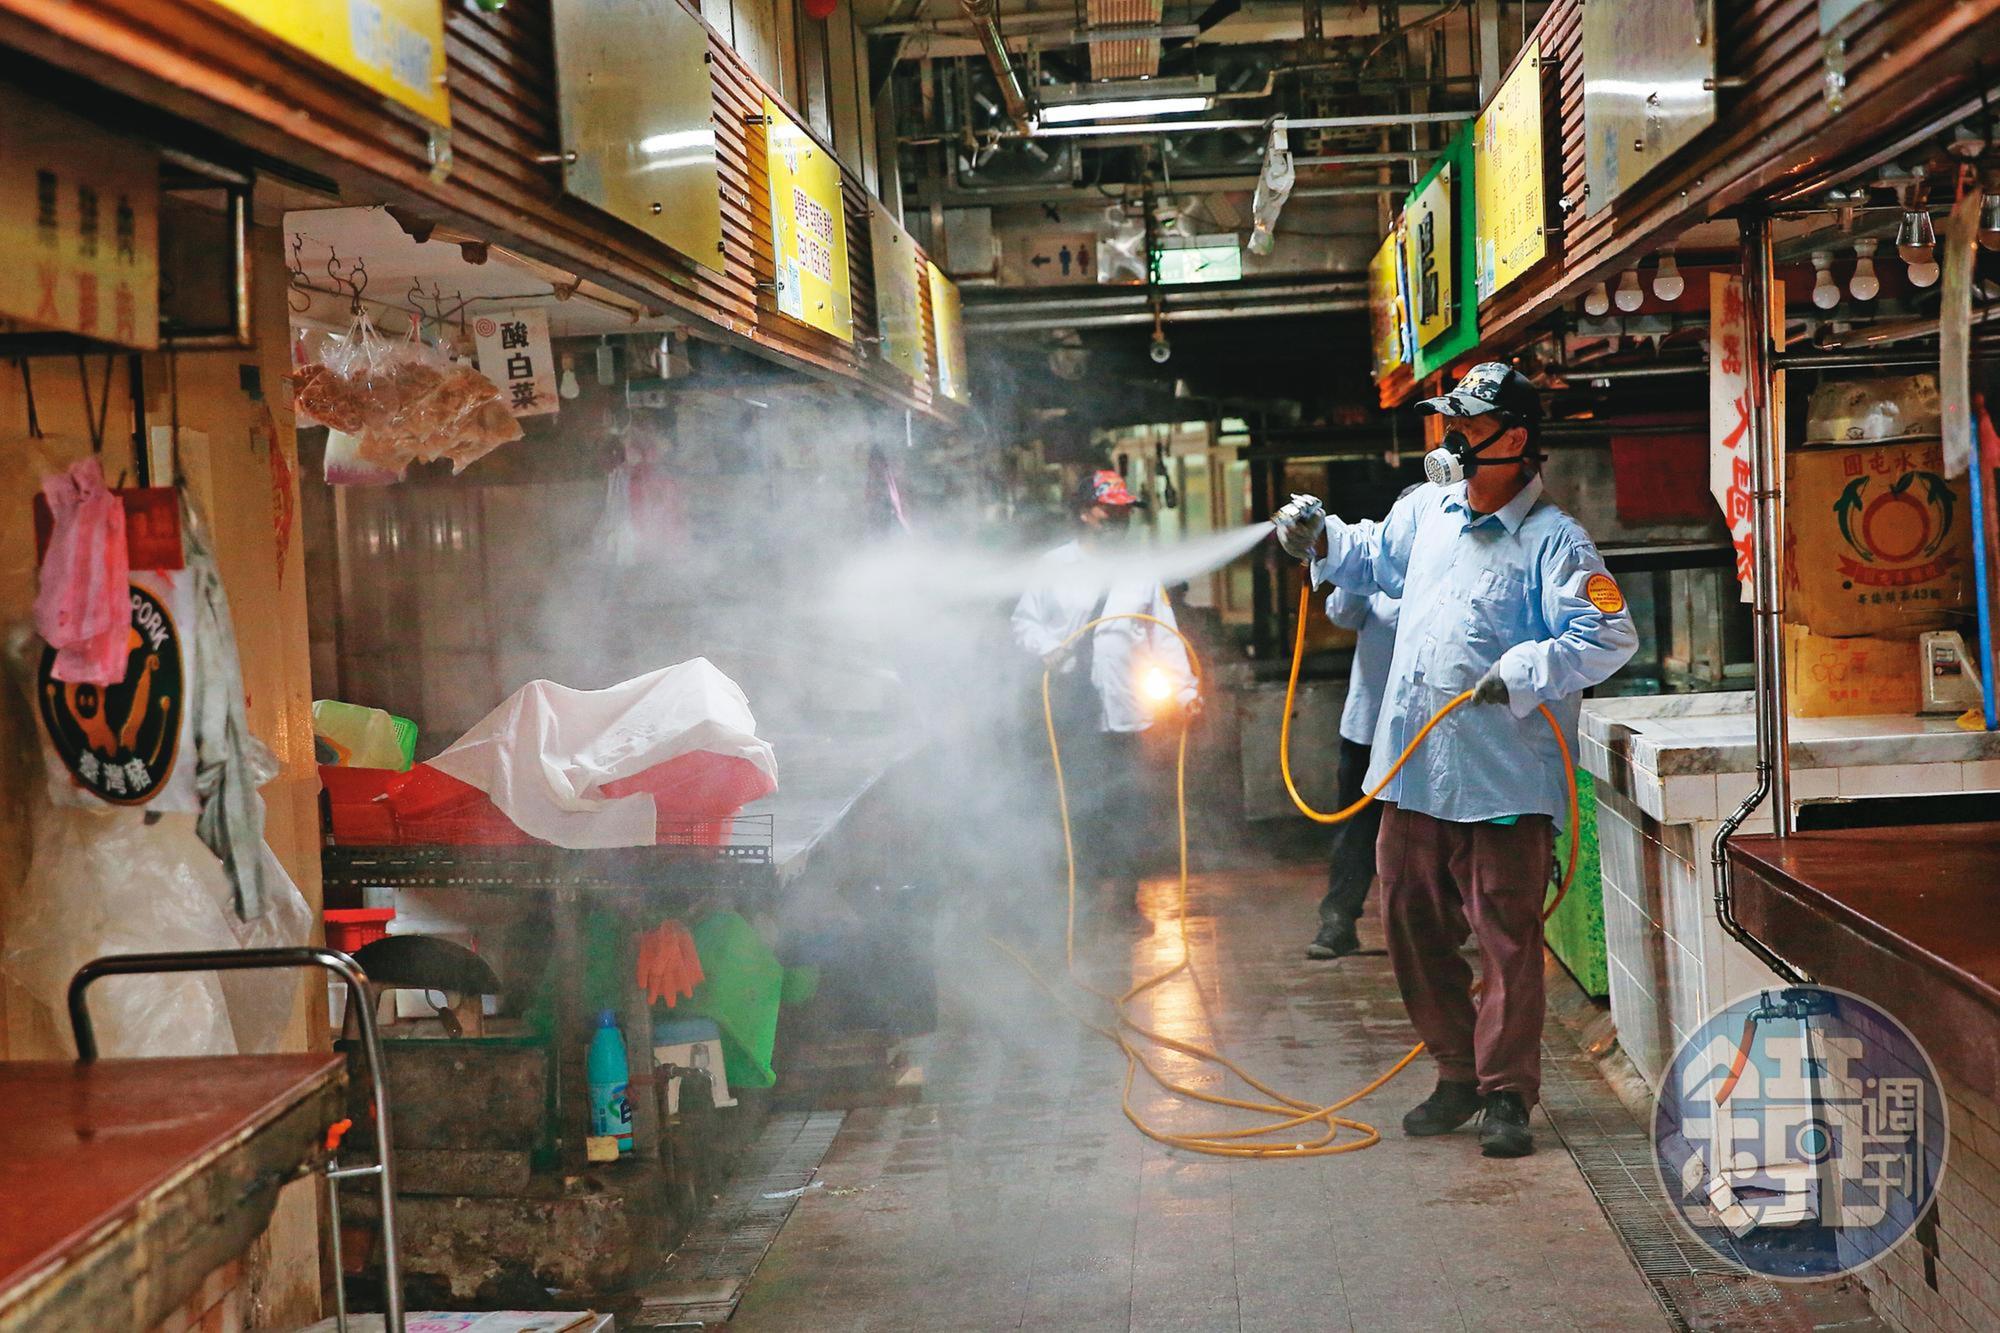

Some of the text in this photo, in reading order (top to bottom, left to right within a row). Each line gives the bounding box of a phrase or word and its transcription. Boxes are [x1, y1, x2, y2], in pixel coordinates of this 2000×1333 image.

[500, 320, 538, 409] 酸白菜
[131, 594, 169, 651] PORK
